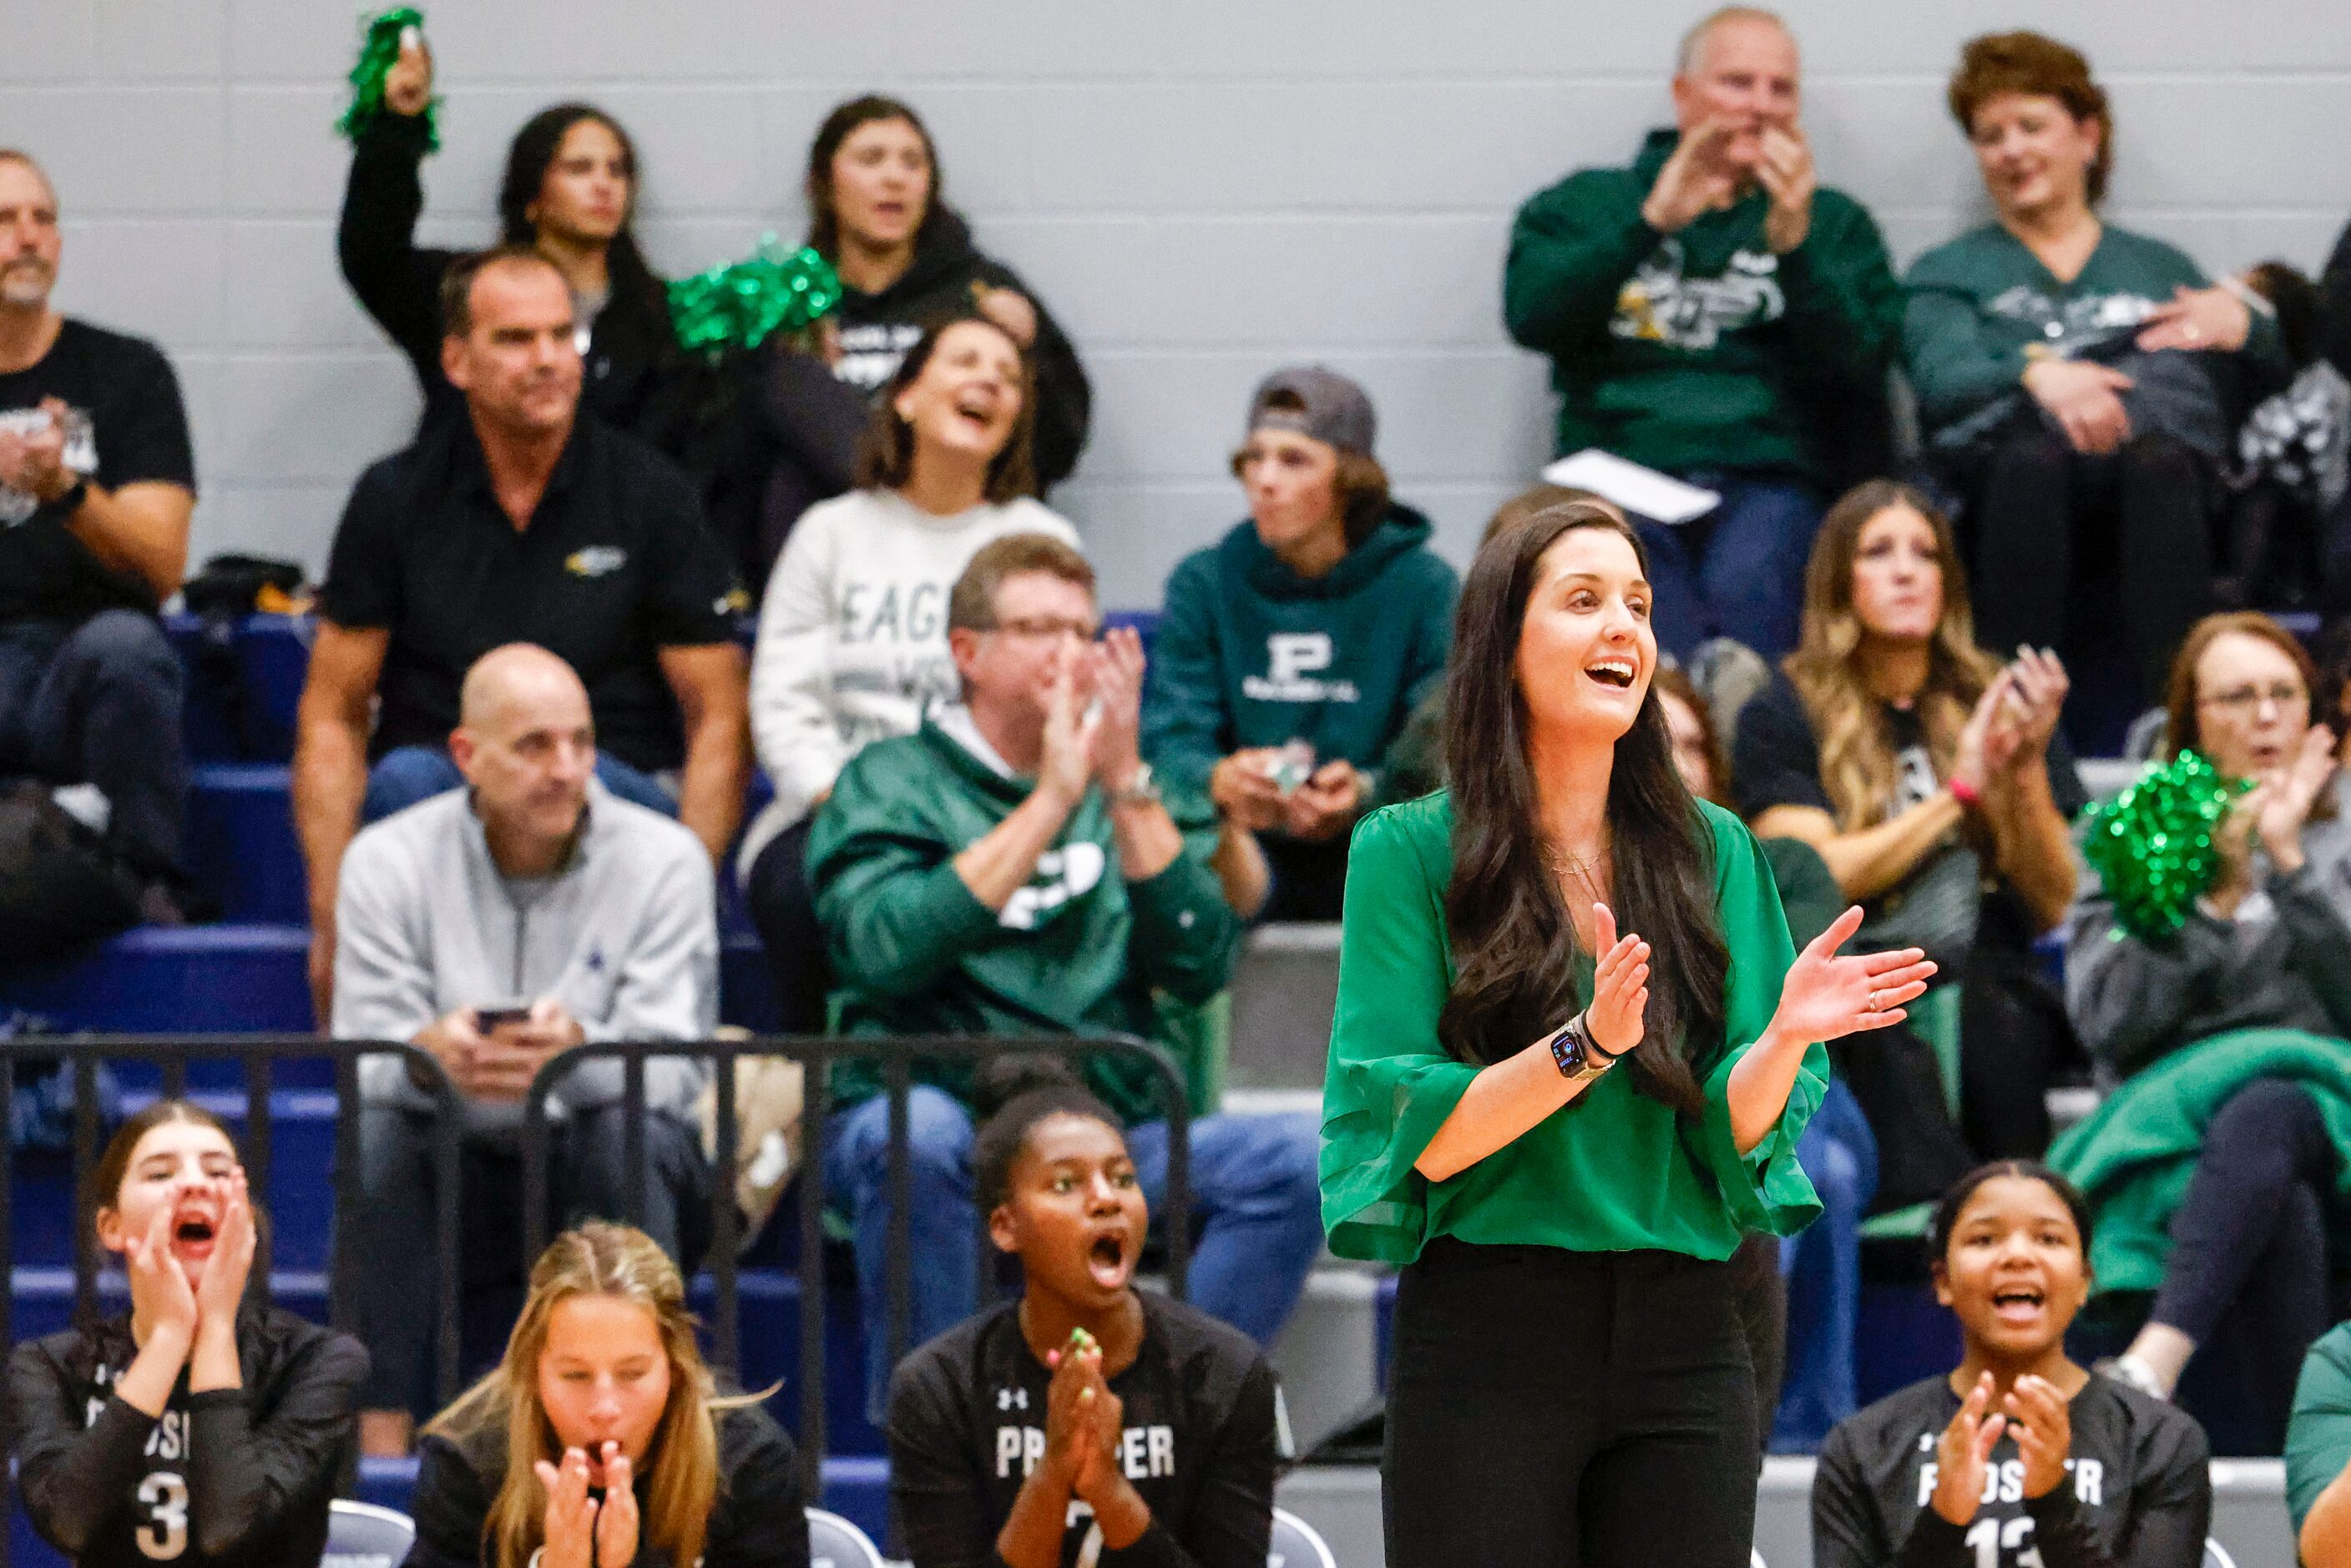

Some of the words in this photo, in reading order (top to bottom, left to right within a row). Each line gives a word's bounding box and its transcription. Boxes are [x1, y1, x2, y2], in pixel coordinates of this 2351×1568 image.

[840, 582, 938, 643] EAG
[1267, 632, 1333, 685] P
[997, 1425, 1176, 1479] PRER
[136, 1471, 189, 1561] 3
